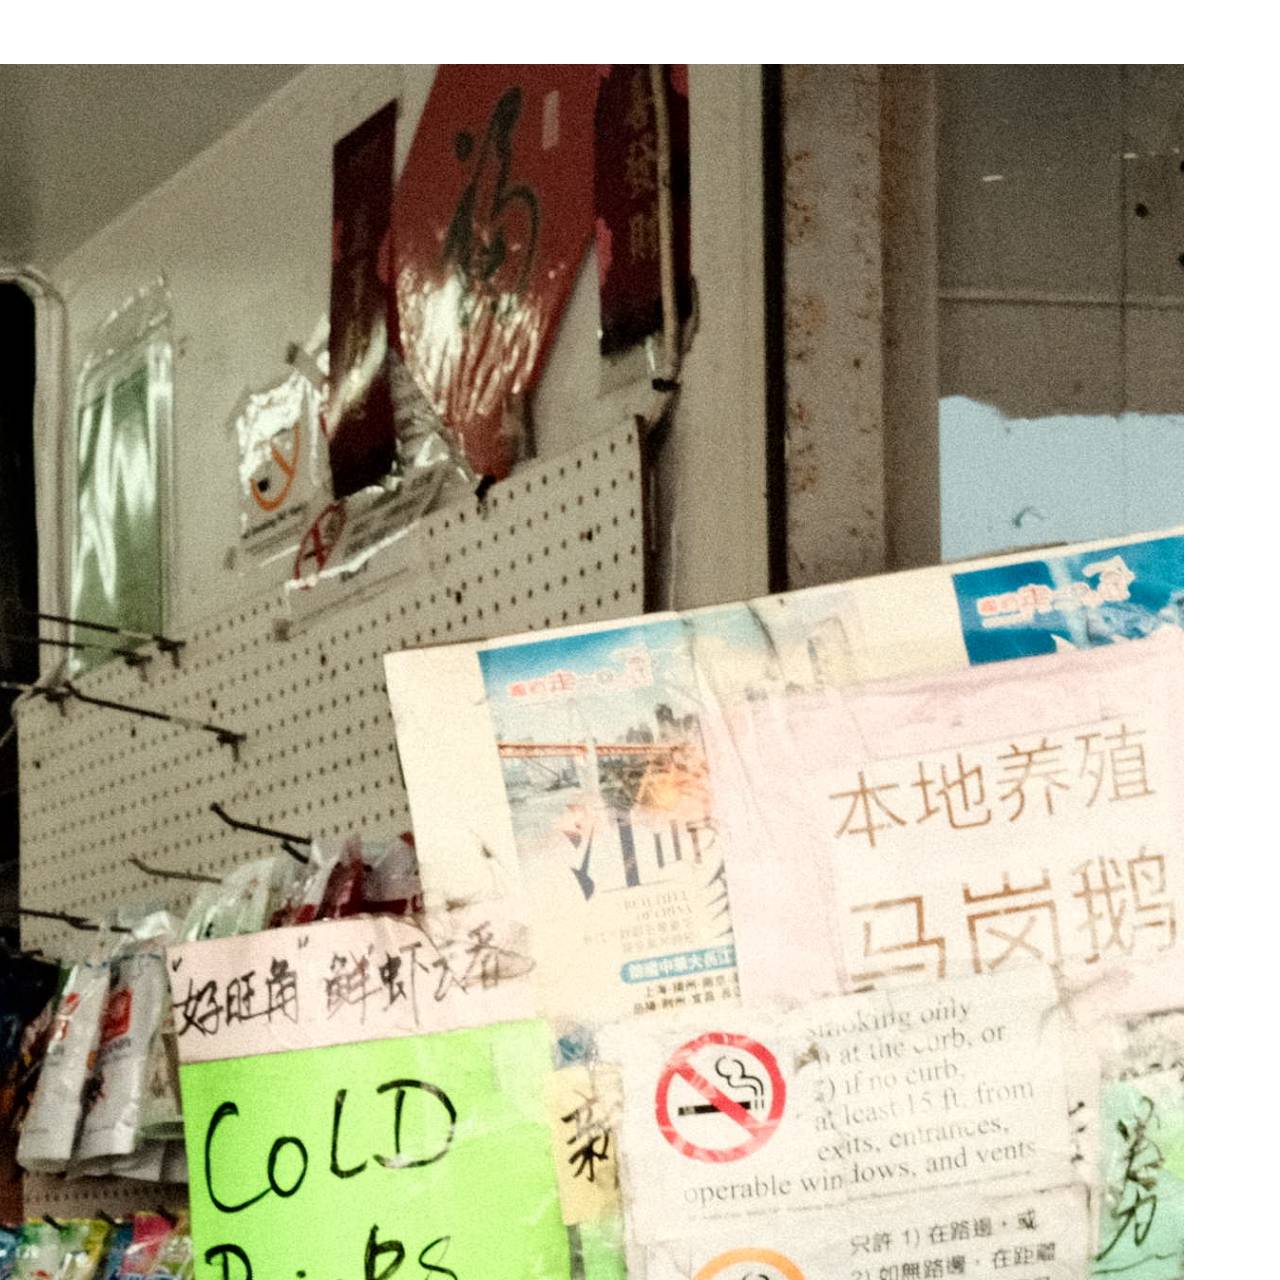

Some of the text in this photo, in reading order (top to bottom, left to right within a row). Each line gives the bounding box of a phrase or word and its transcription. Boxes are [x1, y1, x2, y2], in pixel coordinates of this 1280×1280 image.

[829, 722, 1155, 848] 本地养殖
[847, 846, 1178, 990] 马岗鹅
[919, 997, 971, 1025] only
[980, 1023, 1008, 1045] or
[845, 1069, 864, 1096] if
[843, 1102, 897, 1127] least
[907, 1091, 933, 1116] 15
[975, 1080, 1036, 1106] from
[683, 1174, 792, 1207] operable
[925, 1146, 968, 1175] and
[976, 1138, 1037, 1165] vents
[850, 1232, 893, 1256] 只許
